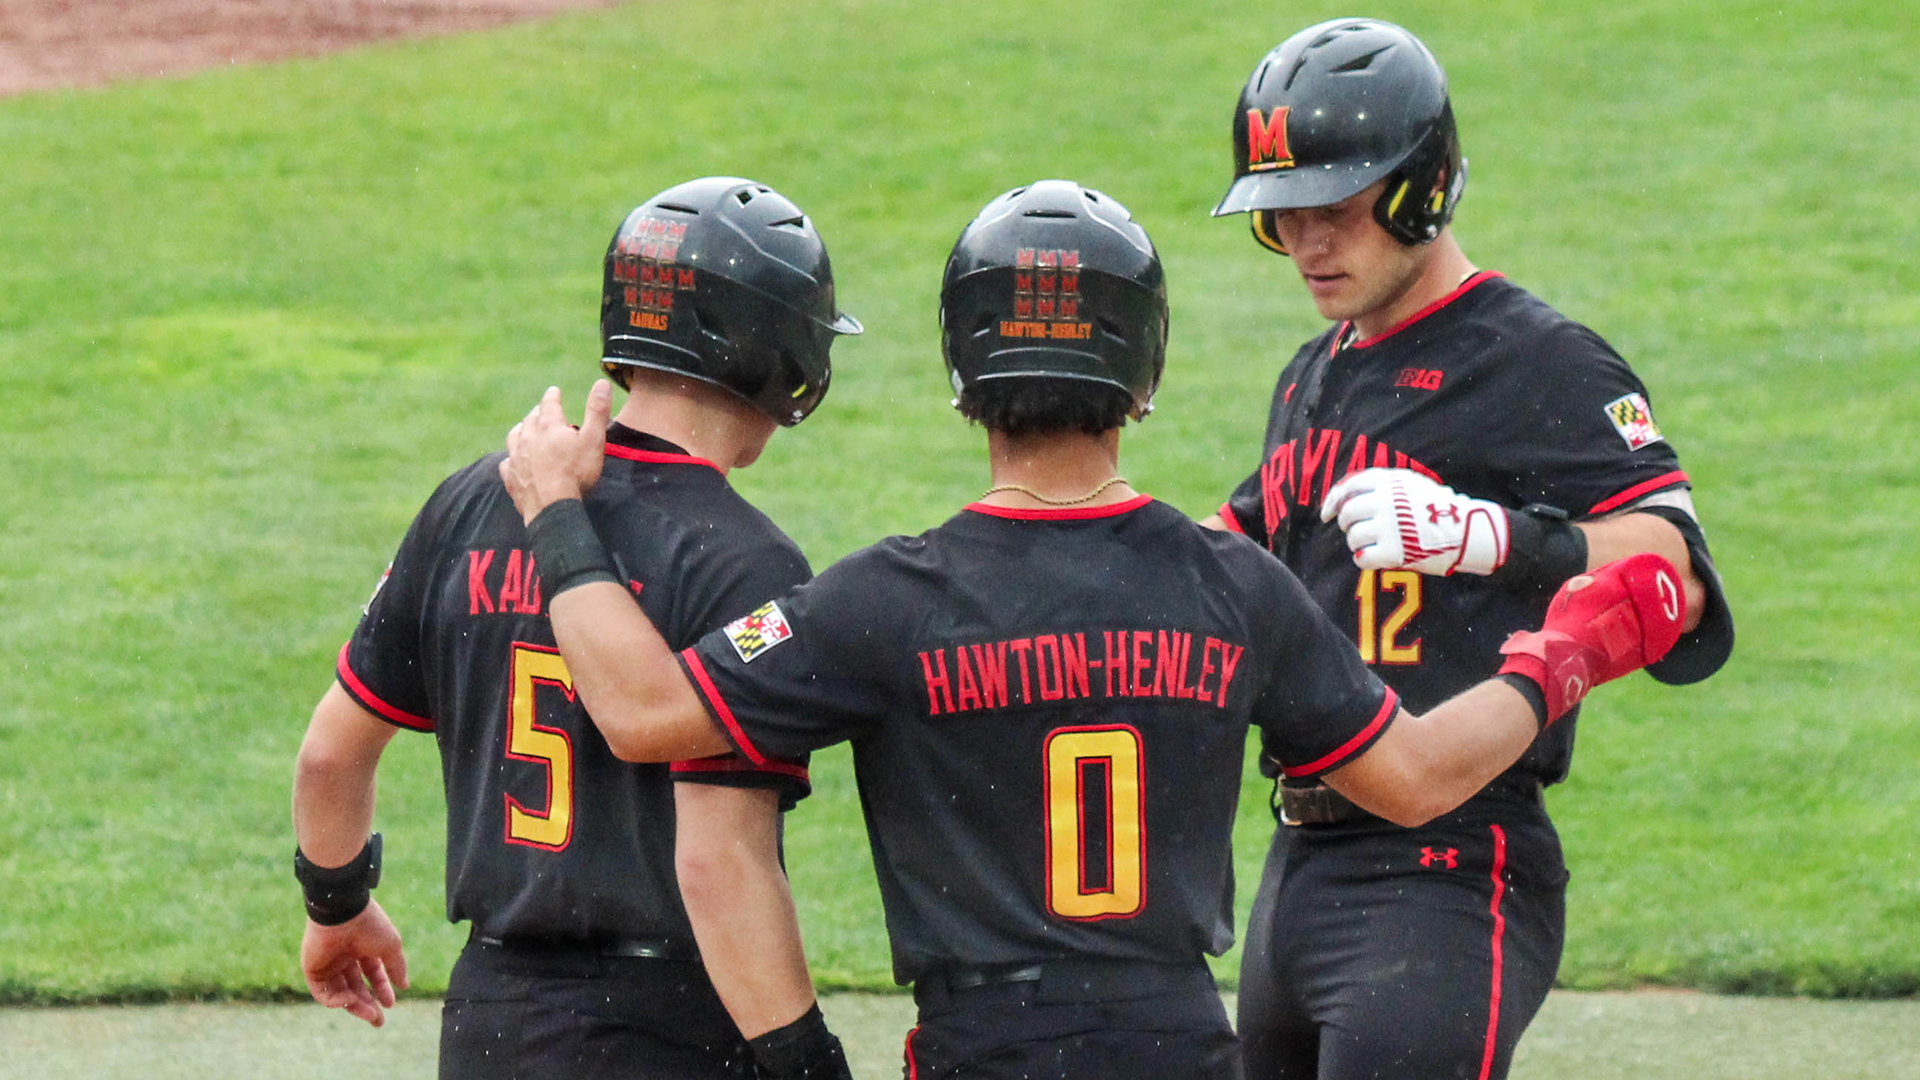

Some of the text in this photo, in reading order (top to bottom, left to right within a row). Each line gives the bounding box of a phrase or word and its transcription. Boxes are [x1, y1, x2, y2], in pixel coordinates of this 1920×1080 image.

[1247, 107, 1293, 163] M
[1355, 568, 1422, 664] 12
[918, 629, 1244, 716] HAWTON-HENLEY
[504, 641, 576, 852] 5
[1042, 723, 1147, 922] 0
